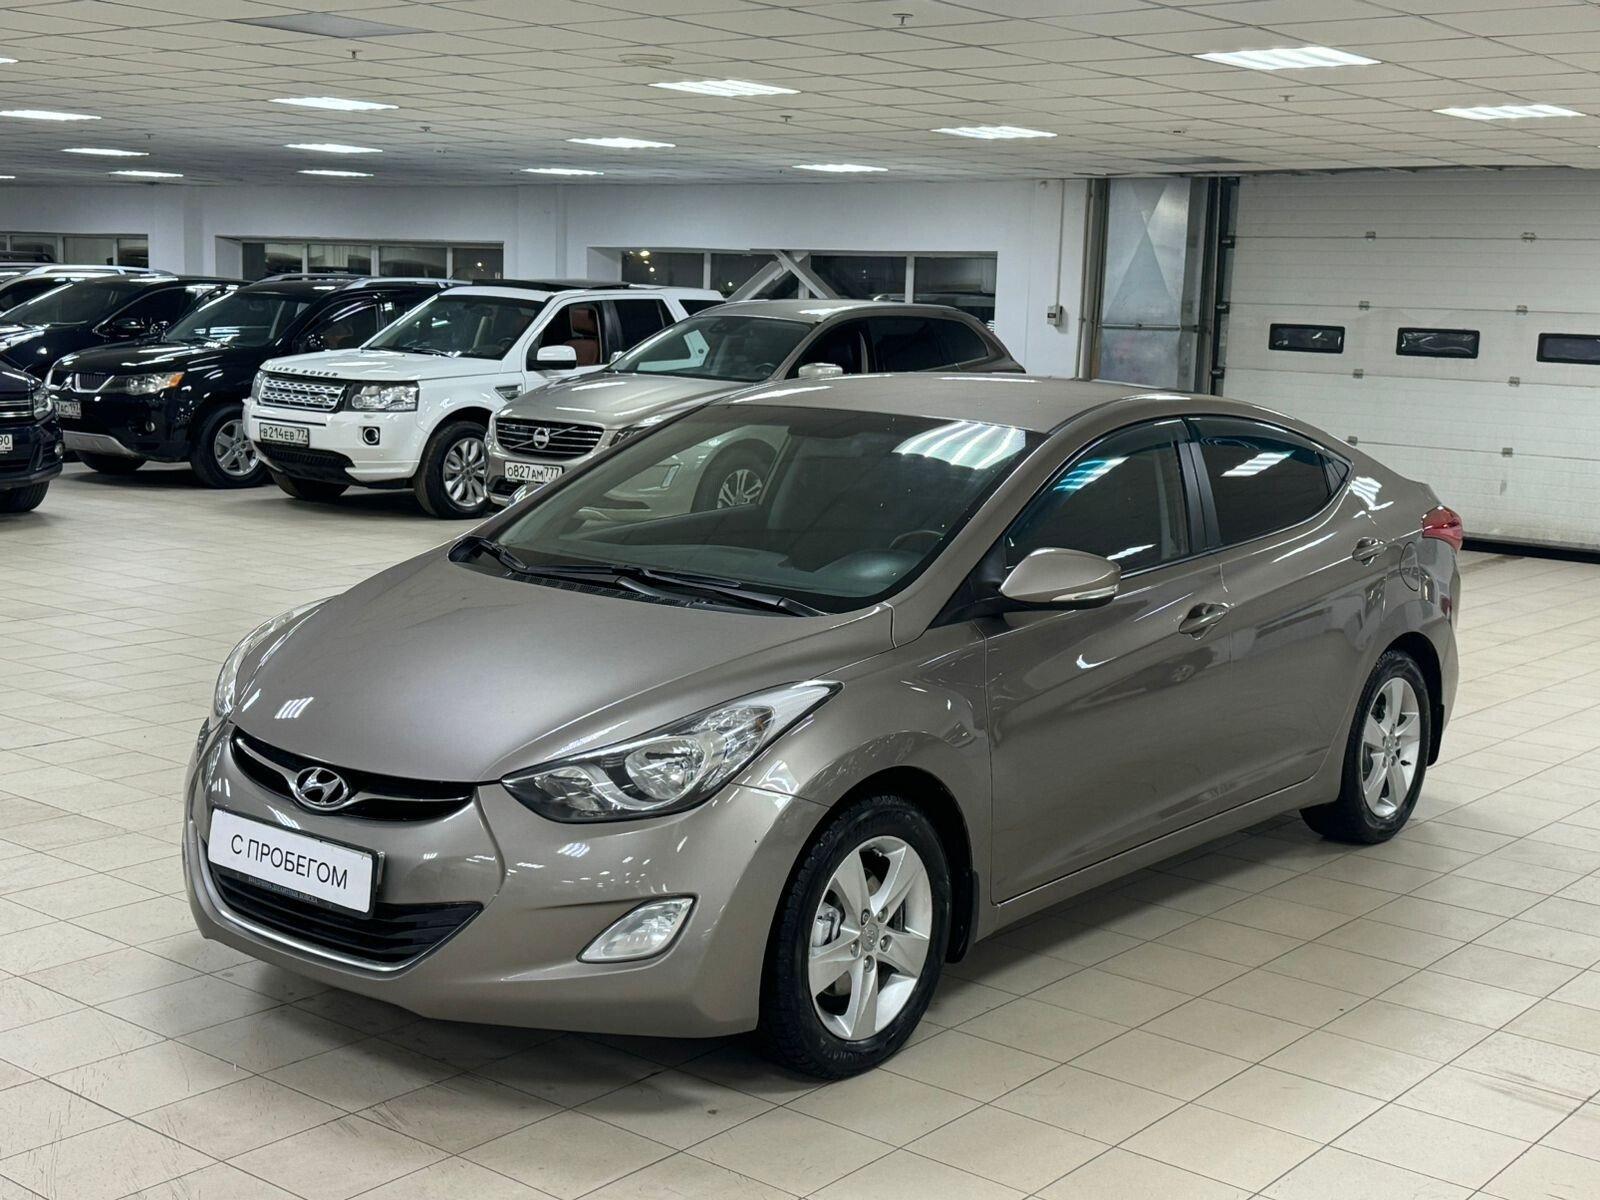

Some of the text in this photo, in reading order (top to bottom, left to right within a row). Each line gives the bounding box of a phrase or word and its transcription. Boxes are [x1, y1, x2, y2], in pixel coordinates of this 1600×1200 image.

[302, 369, 339, 377] ROVER
[230, 834, 348, 889] С ПРОБЕГОМ
